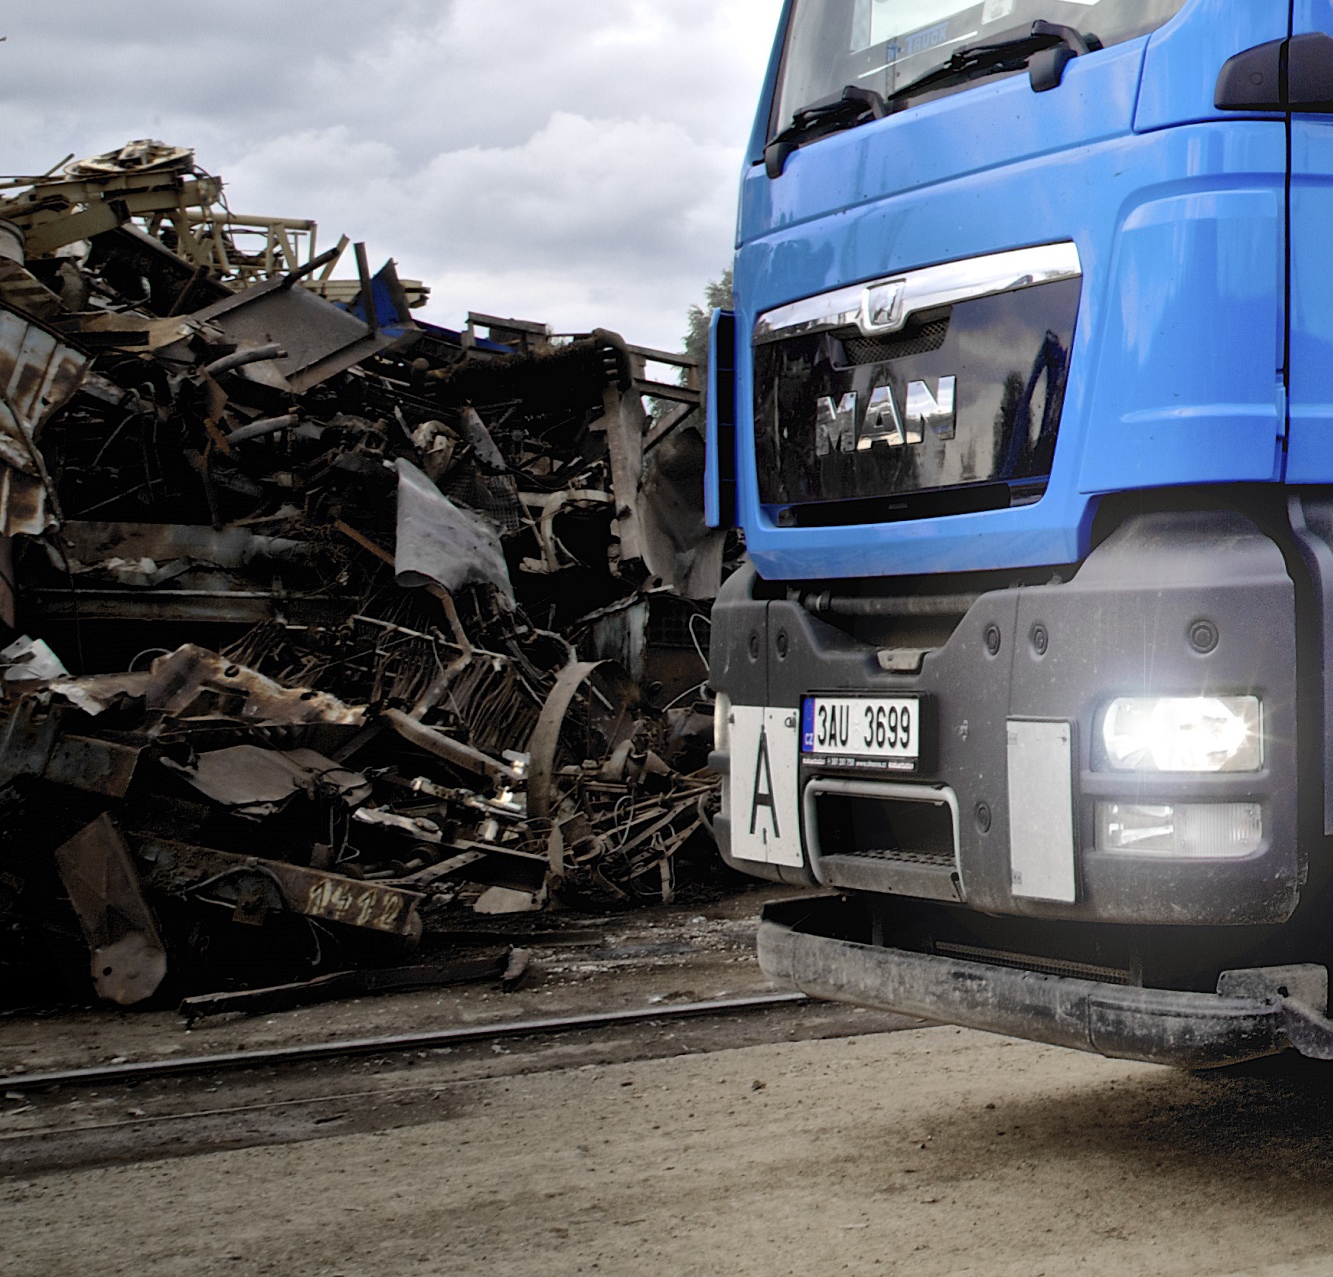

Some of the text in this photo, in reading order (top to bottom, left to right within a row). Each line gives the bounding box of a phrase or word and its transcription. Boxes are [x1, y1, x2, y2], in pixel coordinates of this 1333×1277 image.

[815, 374, 957, 457] MAN
[817, 705, 849, 747] 3AU
[864, 705, 911, 749] 3699
[749, 726, 780, 839] A
